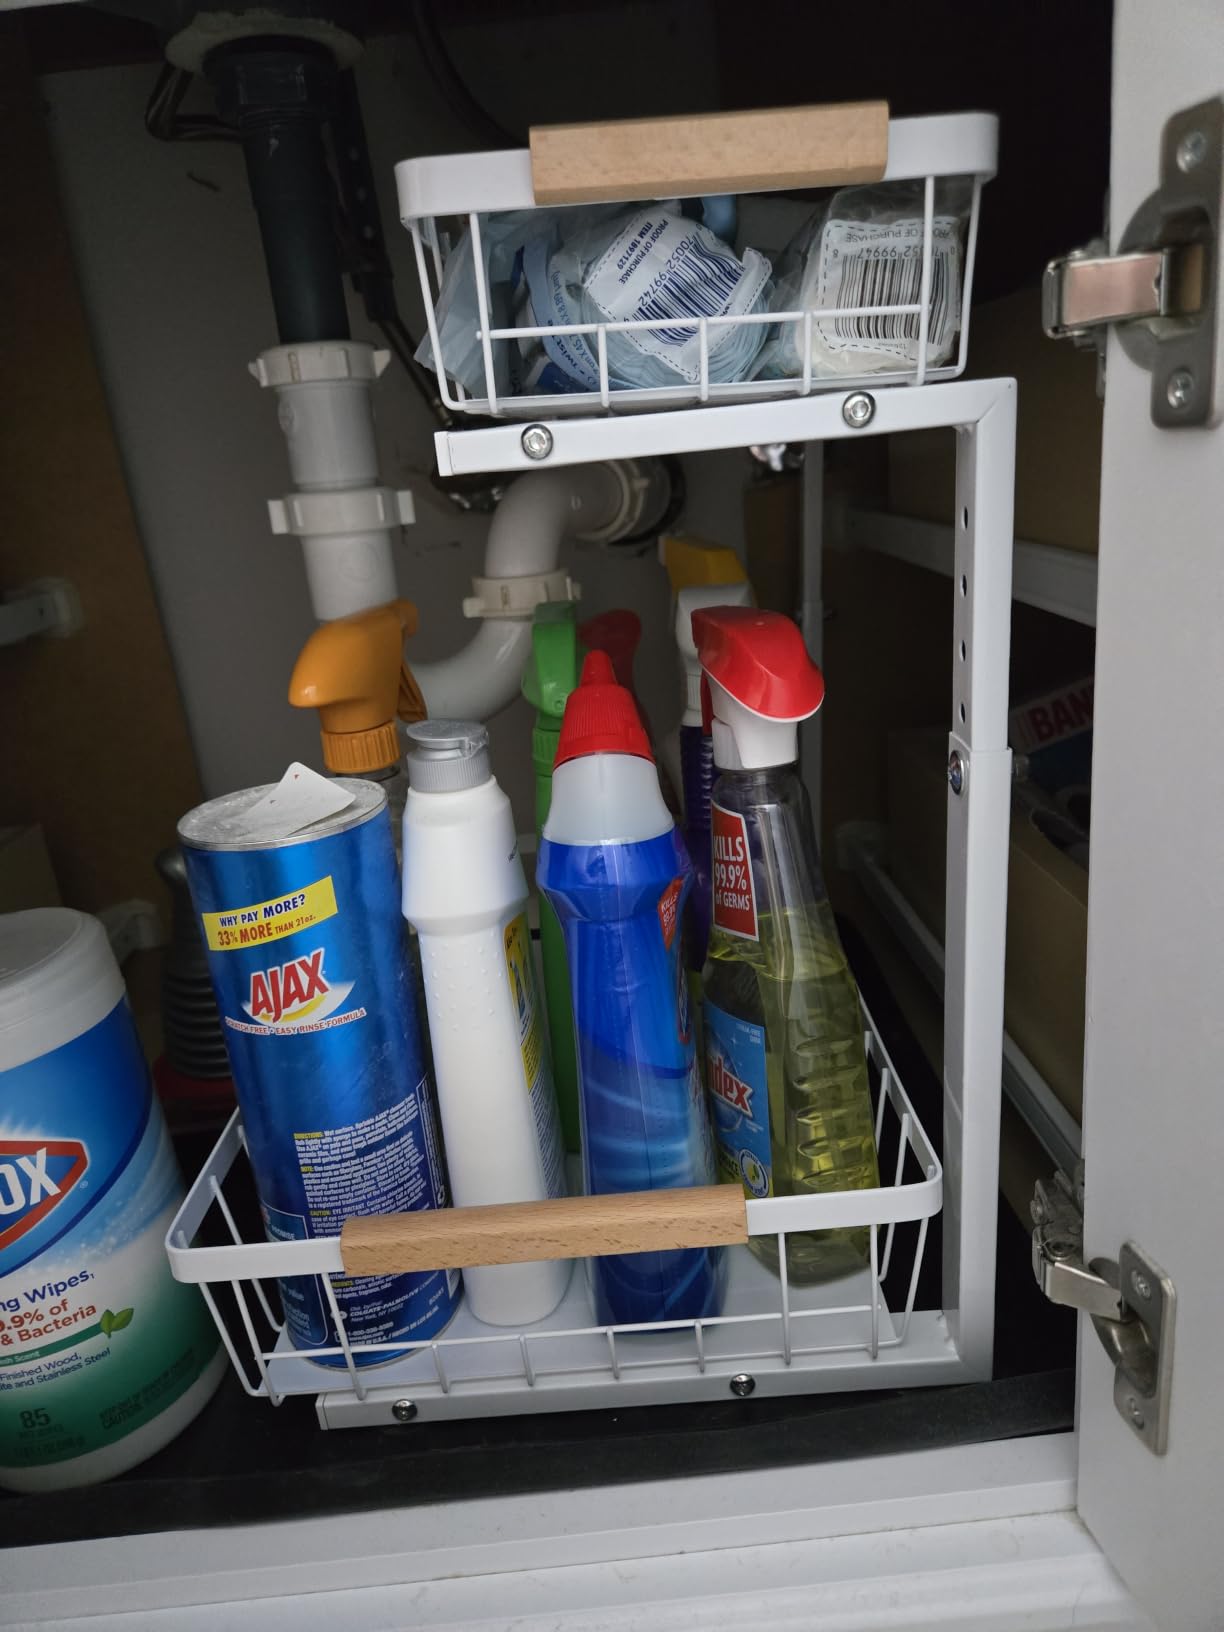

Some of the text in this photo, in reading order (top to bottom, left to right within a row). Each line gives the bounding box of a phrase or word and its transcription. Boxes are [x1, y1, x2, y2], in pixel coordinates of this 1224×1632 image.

[617, 221, 653, 270] ITEM 1897129
[906, 229, 918, 237] OF
[619, 219, 668, 284] PROOF OF PURCHASE
[666, 236, 694, 269] 70052
[833, 249, 838, 258] 8
[858, 246, 897, 259] 99947
[638, 272, 666, 307] 99742
[714, 836, 743, 861] KILLS
[715, 863, 746, 890] 99.9%
[220, 894, 305, 927] WHY PAY MORE?
[218, 930, 238, 945] 33%
[240, 922, 272, 943] MORE
[275, 921, 293, 934] THAN
[251, 951, 329, 1022] AJAX
[300, 1023, 324, 1033] RINSE
[327, 1009, 365, 1026] FORMULA
[50, 1299, 68, 1316] of
[1, 1305, 97, 1345] & Bacteria
[15, 1378, 34, 1388] and
[37, 1363, 83, 1383] Stainless
[85, 1347, 111, 1365] Steel
[44, 1353, 81, 1371] Wood,
[19, 1408, 50, 1429] 85
